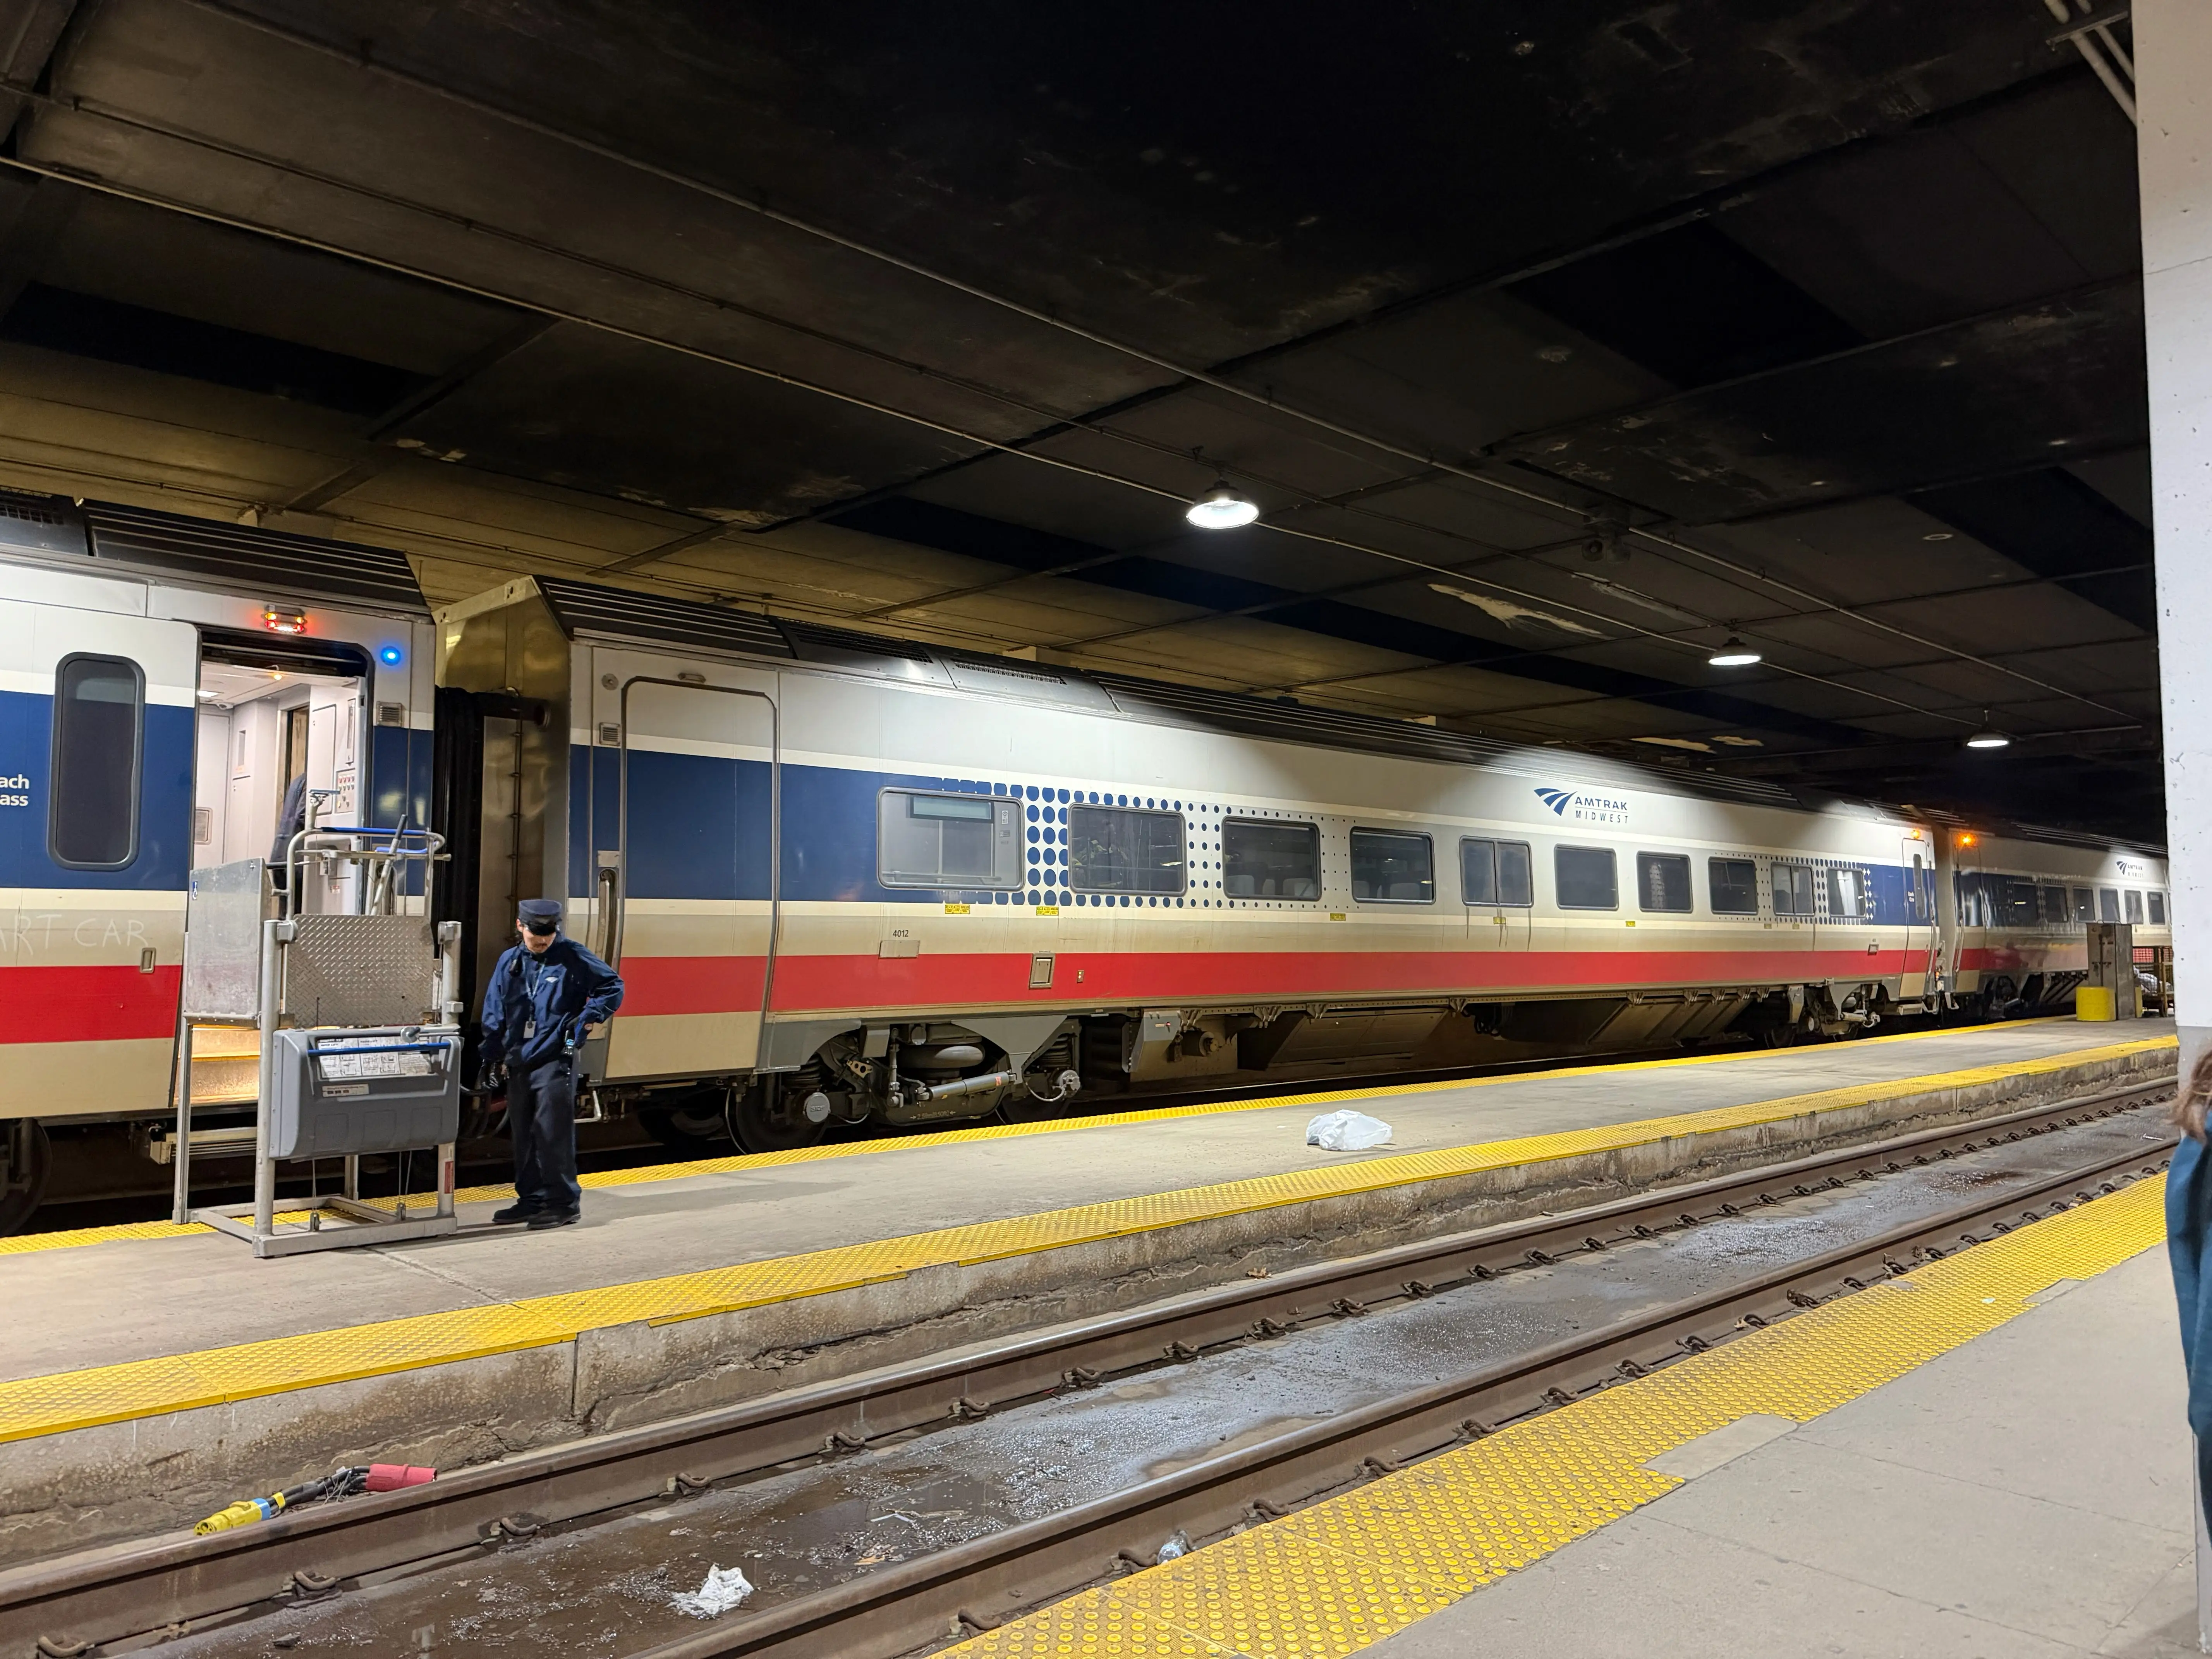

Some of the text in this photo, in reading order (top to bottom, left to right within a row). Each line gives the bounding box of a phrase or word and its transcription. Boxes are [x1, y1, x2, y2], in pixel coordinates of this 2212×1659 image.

[0, 774, 29, 789] ach
[0, 794, 28, 806] ass
[1575, 796, 1627, 810] AMTRAK
[1575, 810, 1628, 824] MIDWEST
[74, 918, 149, 947] CAR
